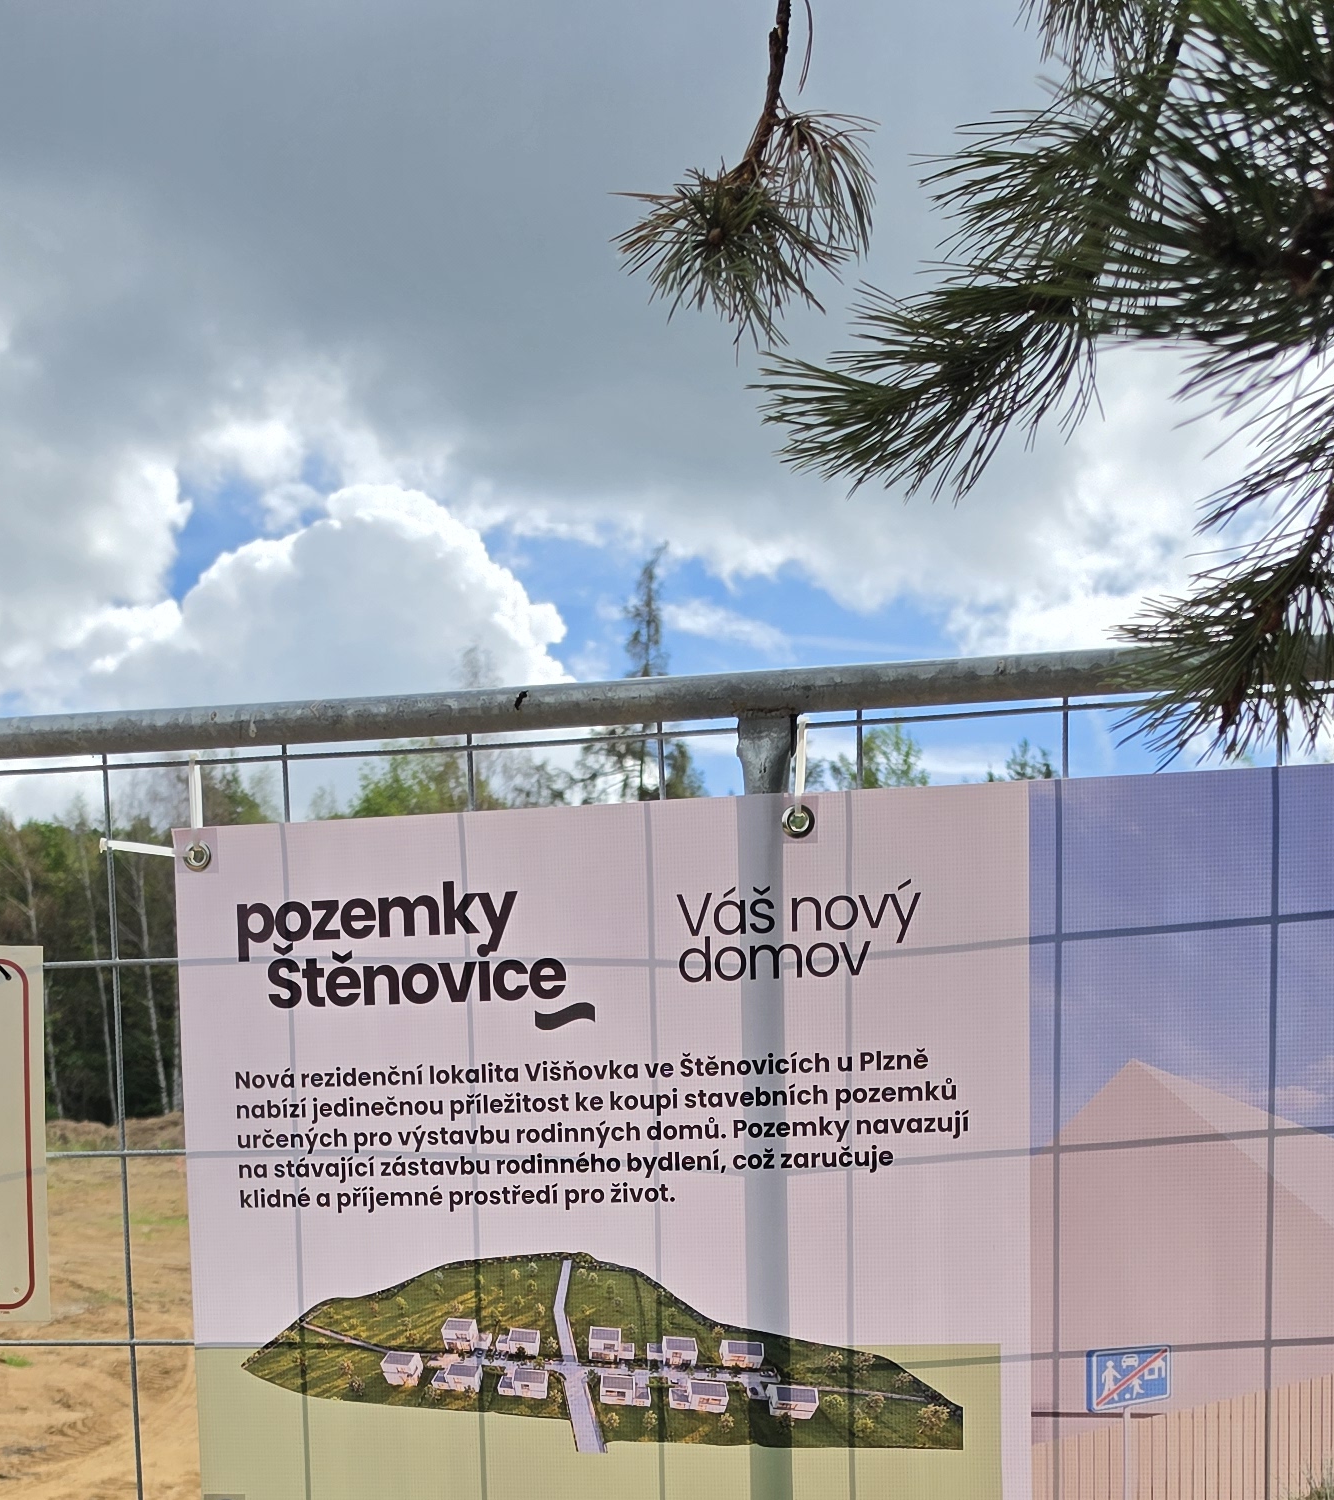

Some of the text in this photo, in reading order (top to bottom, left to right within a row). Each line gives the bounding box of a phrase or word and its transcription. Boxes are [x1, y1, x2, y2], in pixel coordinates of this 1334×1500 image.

[236, 880, 518, 963] pozemky
[676, 878, 922, 944] Váš nový
[267, 943, 568, 1009] Štěnovice
[678, 938, 873, 984] domov
[234, 1047, 929, 1090] Nová rezidenční lokalita Višňovka ve Štěnovicích u Plzně
[236, 1077, 957, 1125] nabízí jedinečnou příležitost ke koupi stavebních pozemků
[237, 1109, 970, 1155] určených pro výstavbu rodinných domů. Pozemky navazují
[238, 1144, 894, 1184] na stávající zástavbu rodinného bydlení, což zaručuje
[239, 1181, 676, 1214] klidné a příjemné prostředí pro život.
